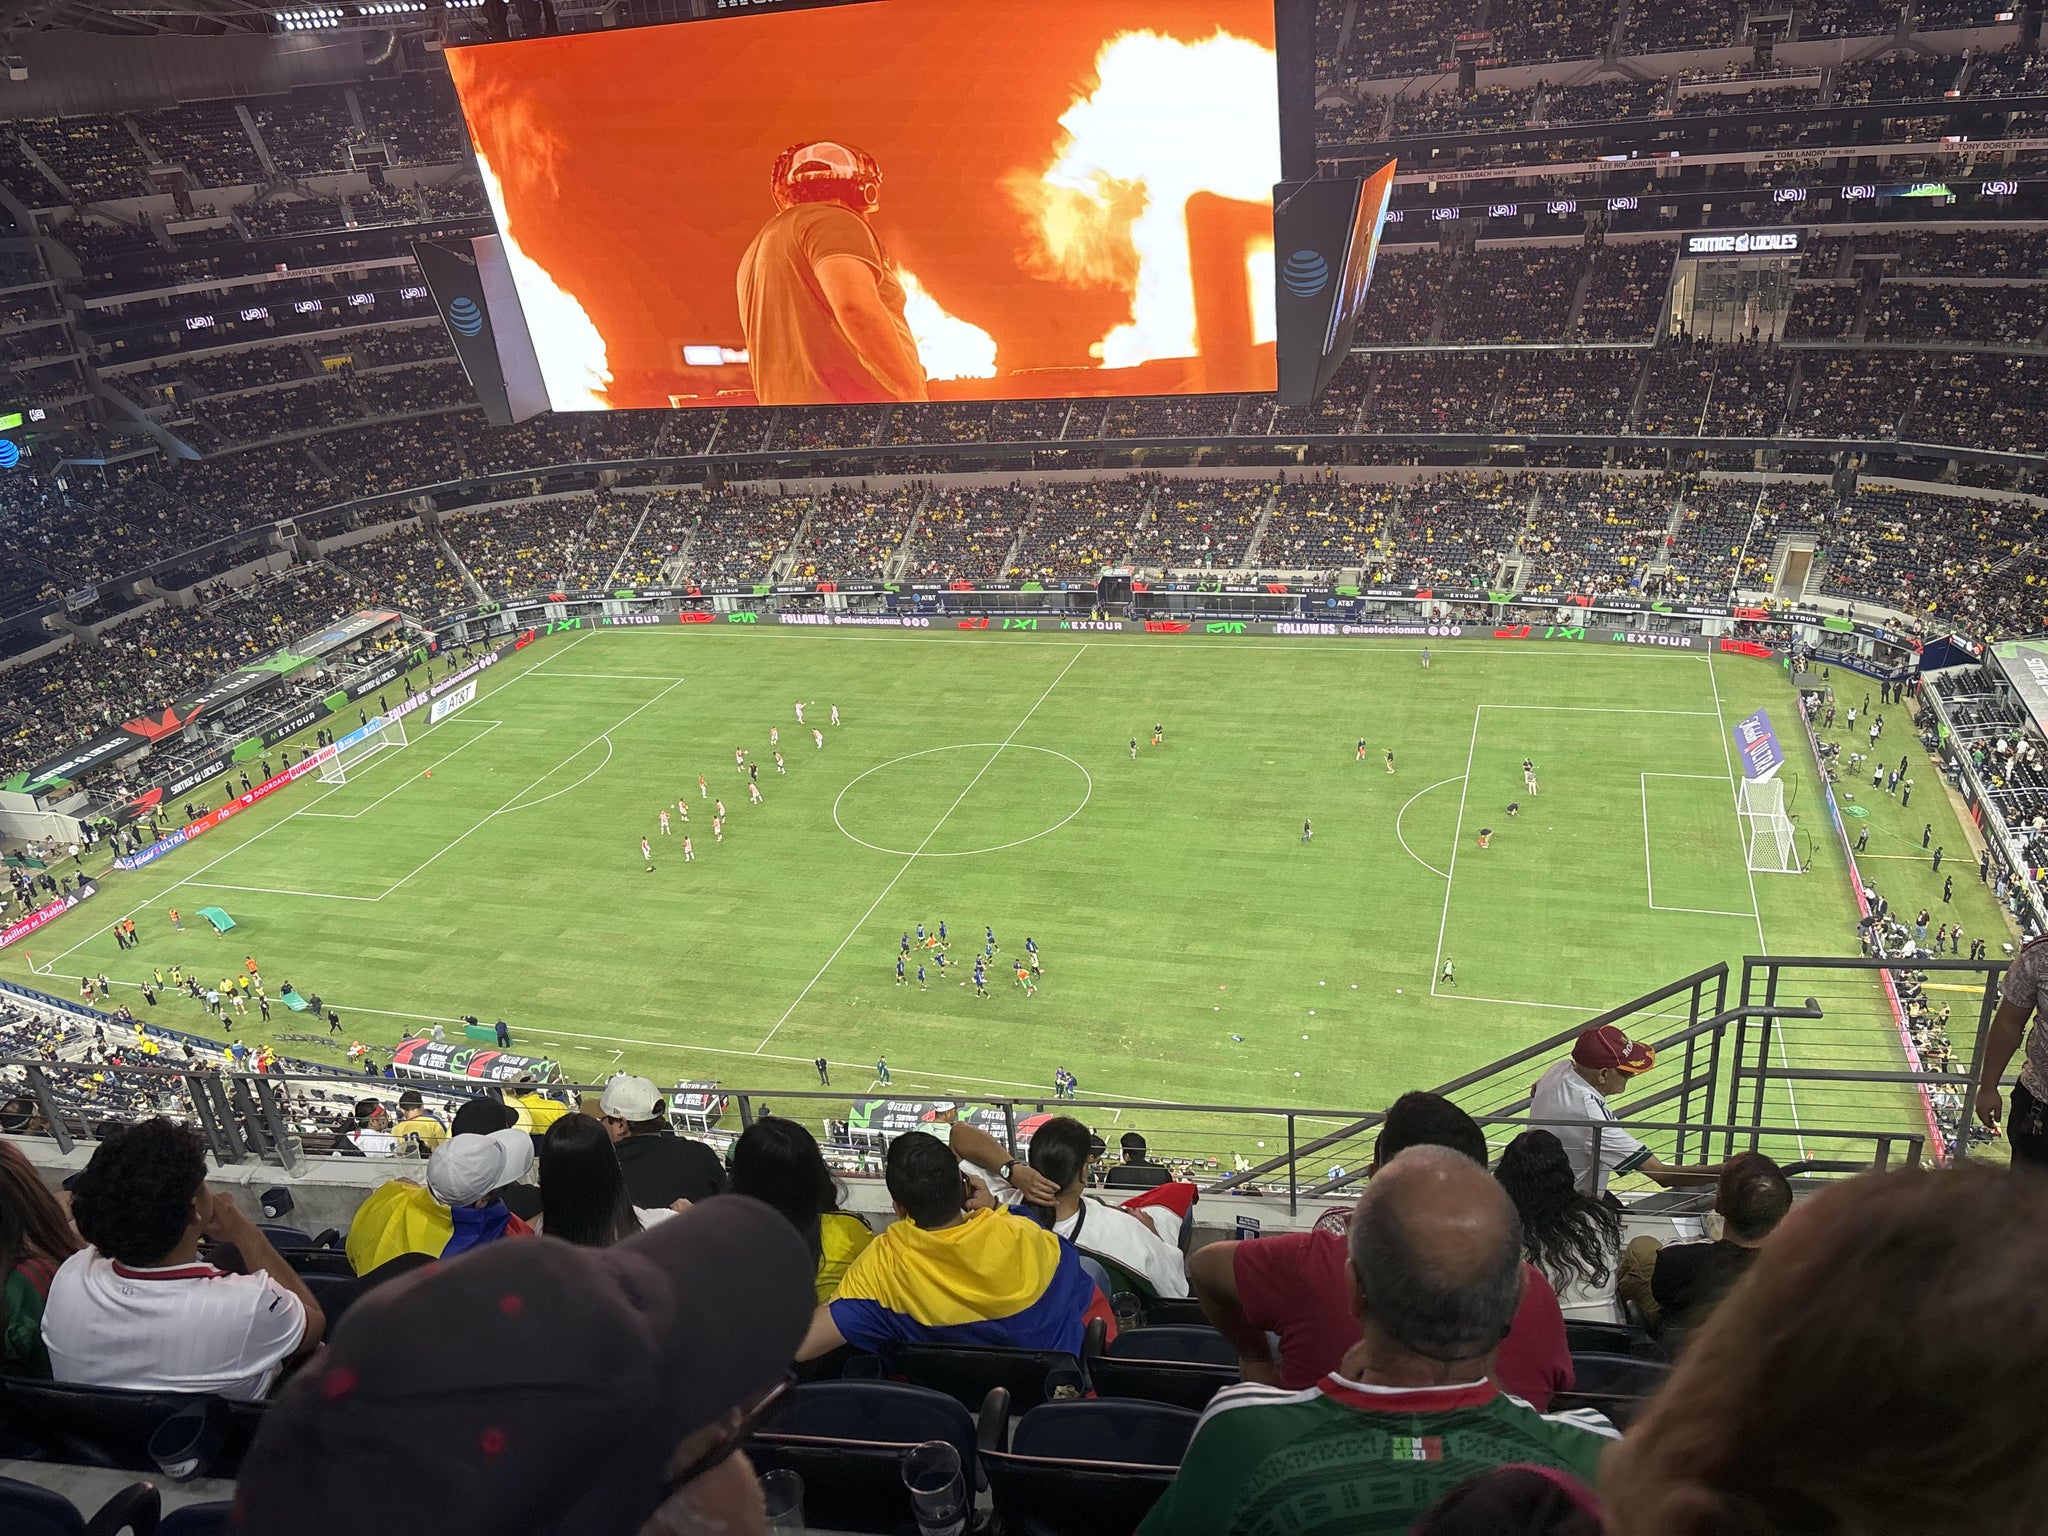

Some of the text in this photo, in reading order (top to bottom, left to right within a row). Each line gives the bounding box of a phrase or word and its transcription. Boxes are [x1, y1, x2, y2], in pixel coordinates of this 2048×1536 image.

[1958, 142, 1980, 150] TONY
[1982, 140, 2024, 150] DORSETT
[1776, 151, 1792, 159] TOM
[1795, 150, 1828, 158] LANDRY
[1600, 162, 1613, 170] LEE
[1629, 160, 1657, 168] JORDAN
[1437, 172, 1458, 180] ROGER
[1460, 170, 1492, 180] STAUBACH
[1750, 234, 1798, 251] LOCALES
[602, 615, 660, 626] MEXTOUR
[781, 614, 814, 624] FOLLOW
[815, 614, 830, 624] US
[1060, 621, 1122, 630] MEXTOUR
[1776, 614, 1817, 623] MEXTOUR
[1276, 623, 1319, 634] FOLLOW
[1321, 624, 1336, 634] US
[1612, 632, 1692, 648] MEXTOUR
[1883, 634, 1898, 643] AT&T
[388, 697, 414, 721] FOLLOW
[414, 692, 428, 708] US
[448, 686, 472, 711] AT&T
[270, 712, 316, 741] MEXTOUR
[291, 746, 337, 779] BURGER KING
[1750, 740, 1776, 776] ULTRA
[202, 760, 224, 781] LOCALES
[254, 772, 290, 798] DOORDASH
[160, 833, 186, 852] ULTRA
[0, 924, 30, 946] Casillero
[39, 904, 64, 921] Diablo
